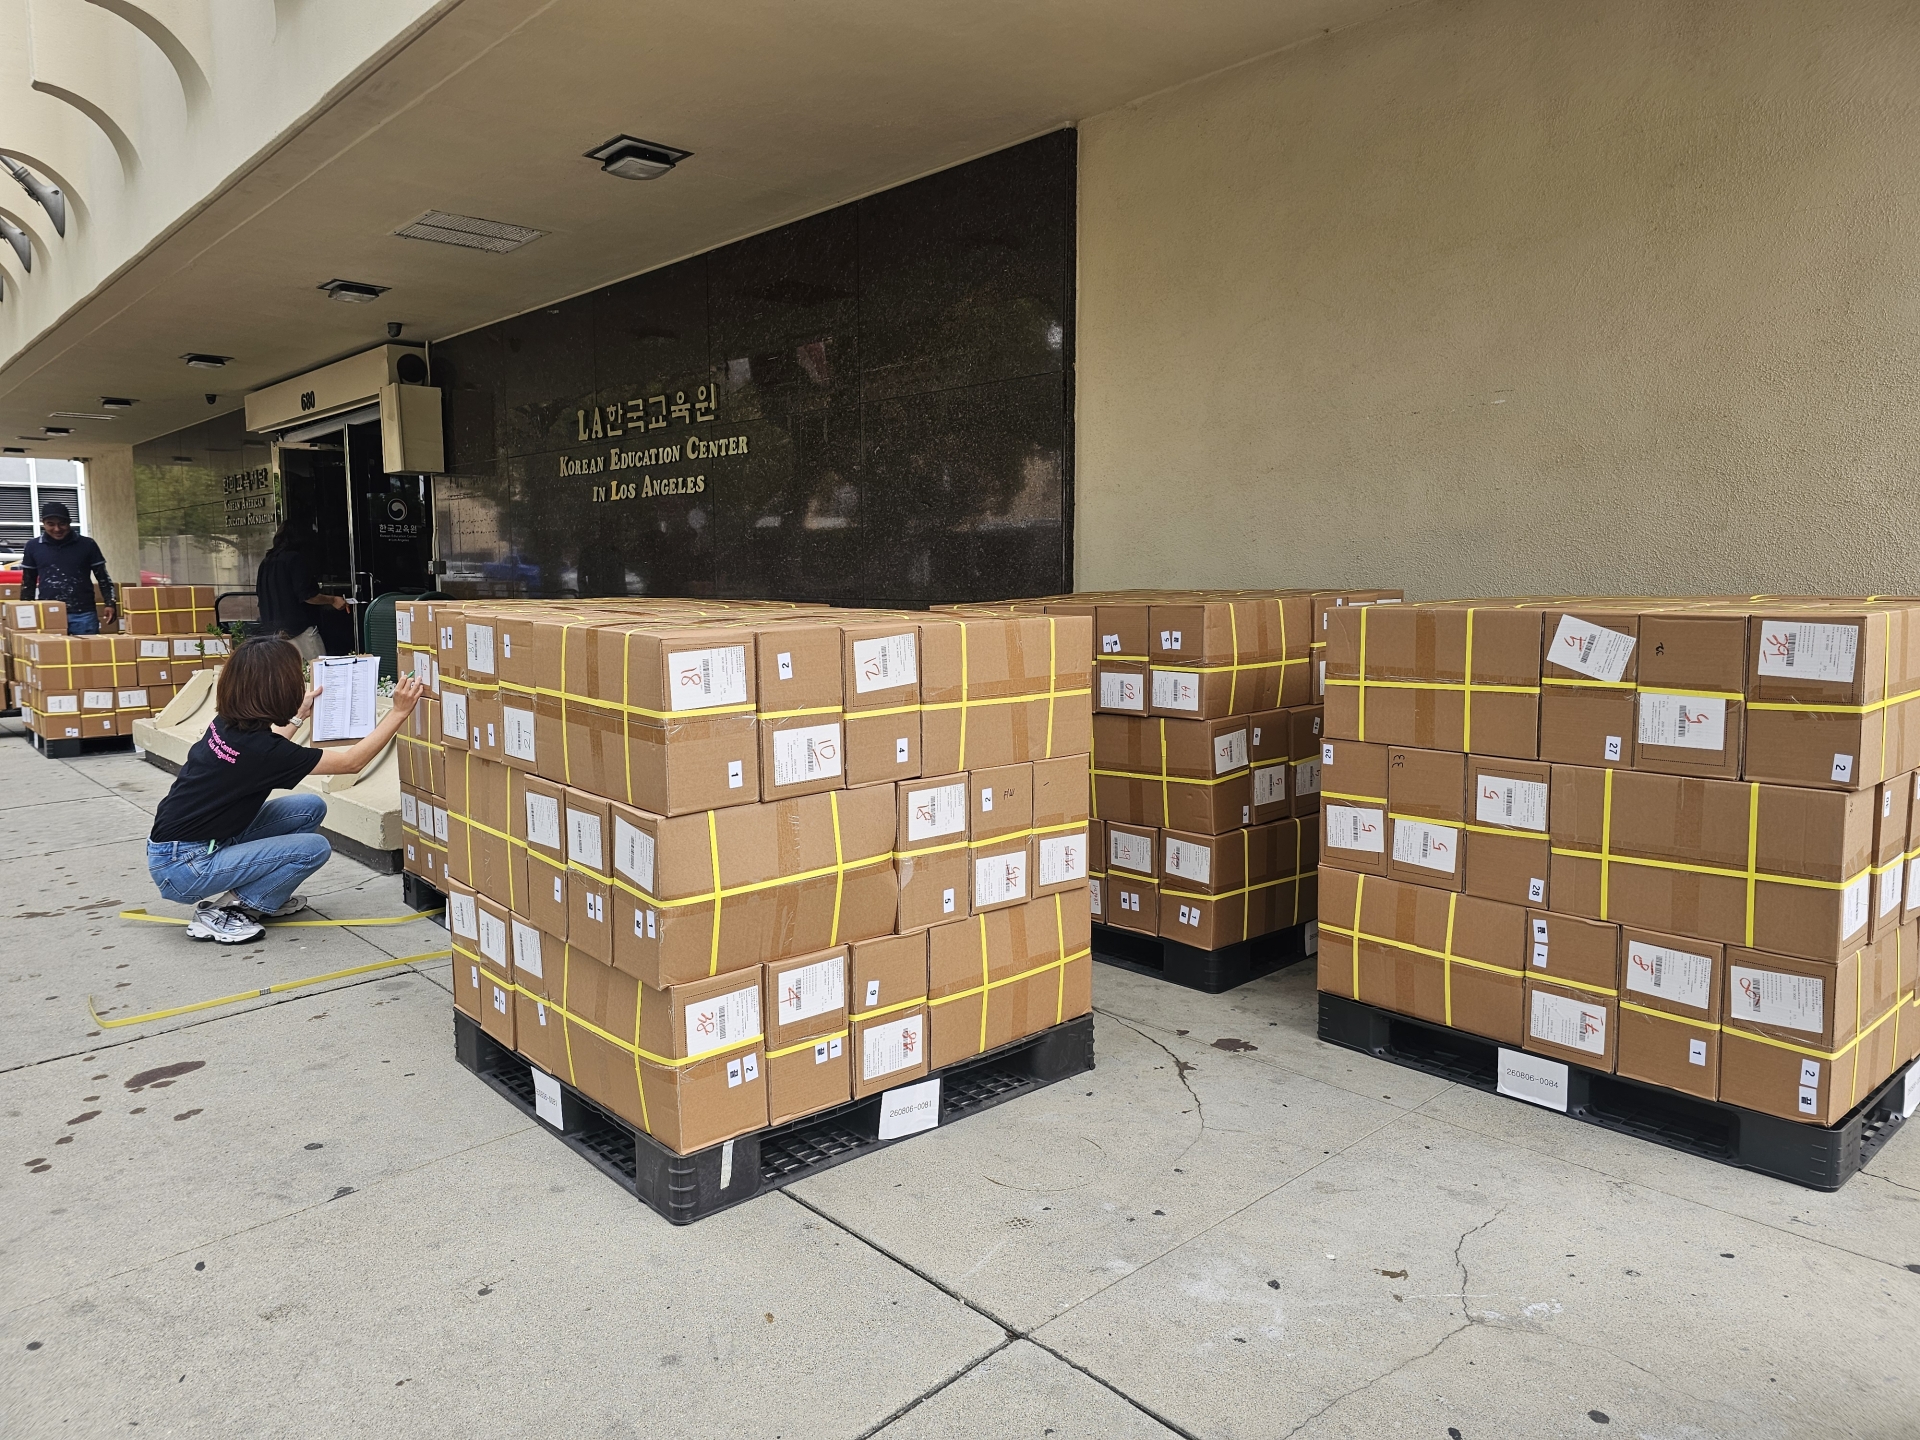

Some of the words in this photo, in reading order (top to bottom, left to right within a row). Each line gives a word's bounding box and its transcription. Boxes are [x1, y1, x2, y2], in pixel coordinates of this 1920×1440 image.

[301, 390, 316, 411] 680
[578, 383, 716, 440] LA한국교육원
[379, 524, 417, 534] 한국교육원
[1766, 634, 1790, 656] 39
[680, 667, 702, 686] 18
[864, 657, 880, 682] 12
[1124, 683, 1135, 700] 60
[1684, 712, 1710, 724] 5
[818, 739, 836, 760] 10
[1325, 748, 1332, 759] 29
[1609, 742, 1618, 754] 27
[1391, 754, 1406, 768] 33
[1484, 786, 1500, 800] 5
[916, 804, 933, 821] 18
[1362, 822, 1377, 833] 5
[1432, 838, 1448, 852] 5
[1532, 884, 1541, 897] 28
[1632, 954, 1650, 972] 8
[780, 986, 800, 1008] 4
[696, 1011, 715, 1036] 38
[902, 1030, 917, 1052] 48
[1506, 1068, 1559, 1089] 260806-0084
[889, 1100, 932, 1118] 260806-0081
